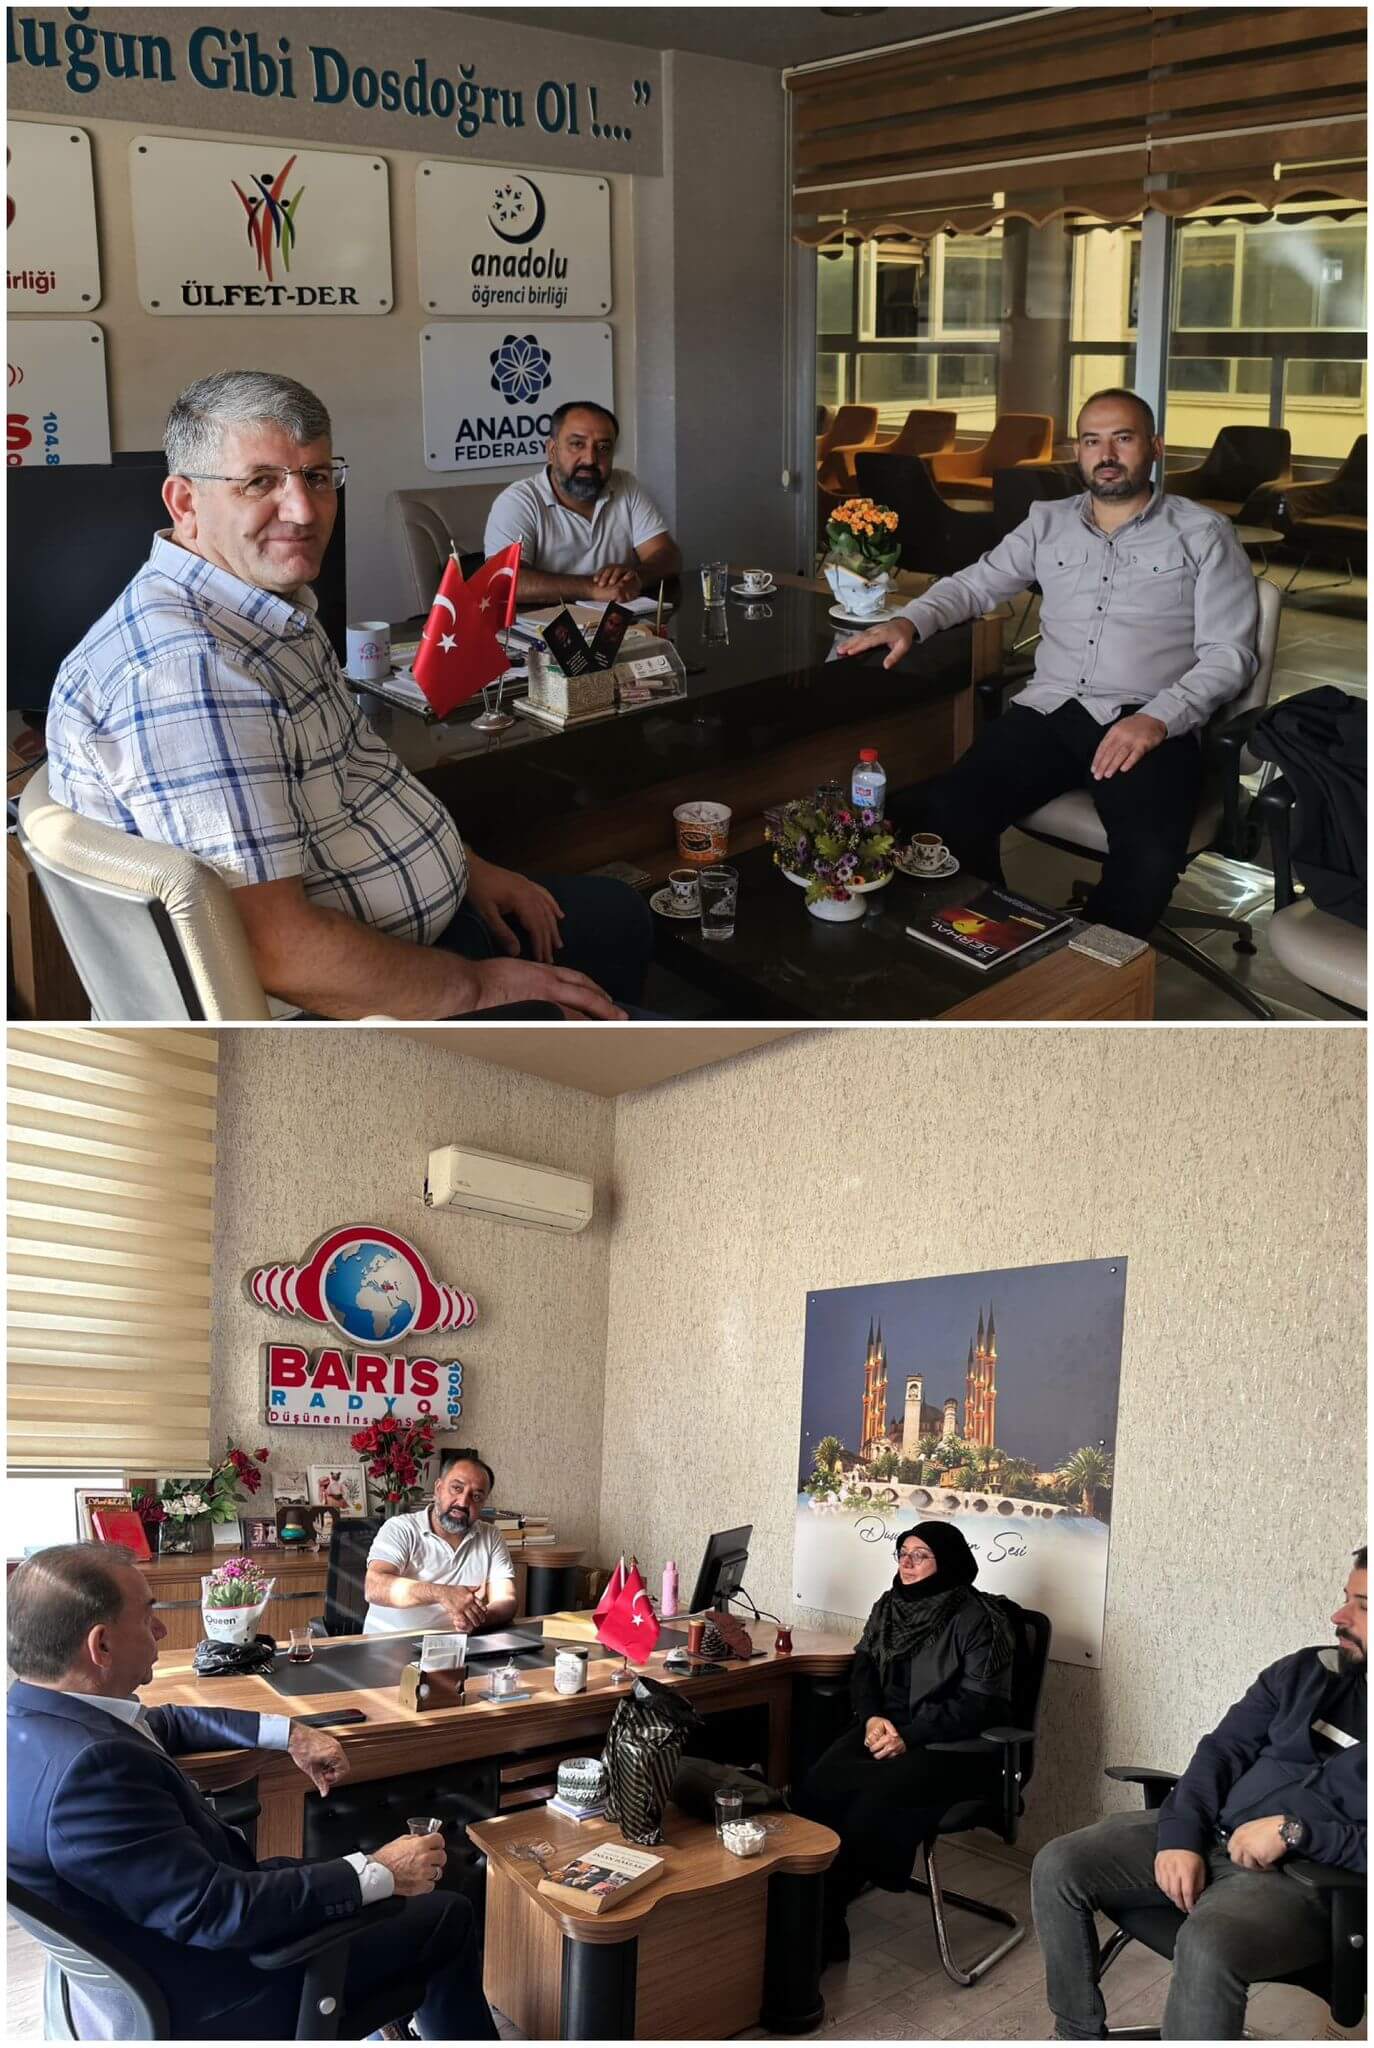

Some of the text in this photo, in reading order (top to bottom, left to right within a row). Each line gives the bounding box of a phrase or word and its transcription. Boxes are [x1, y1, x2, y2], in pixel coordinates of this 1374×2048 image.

[188, 26, 297, 98] Gibi
[308, 45, 526, 138] Dosdoğru
[536, 80, 581, 135] Ol
[471, 247, 568, 279] anadolu
[181, 280, 360, 307] ÜLFET-DER
[471, 285, 568, 309] öğrenci birliği
[43, 412, 60, 466] 104.8
[447, 1361, 461, 1416] 104.8
[270, 1411, 341, 1425] Düşünen
[986, 1531, 1028, 1563] Sesi
